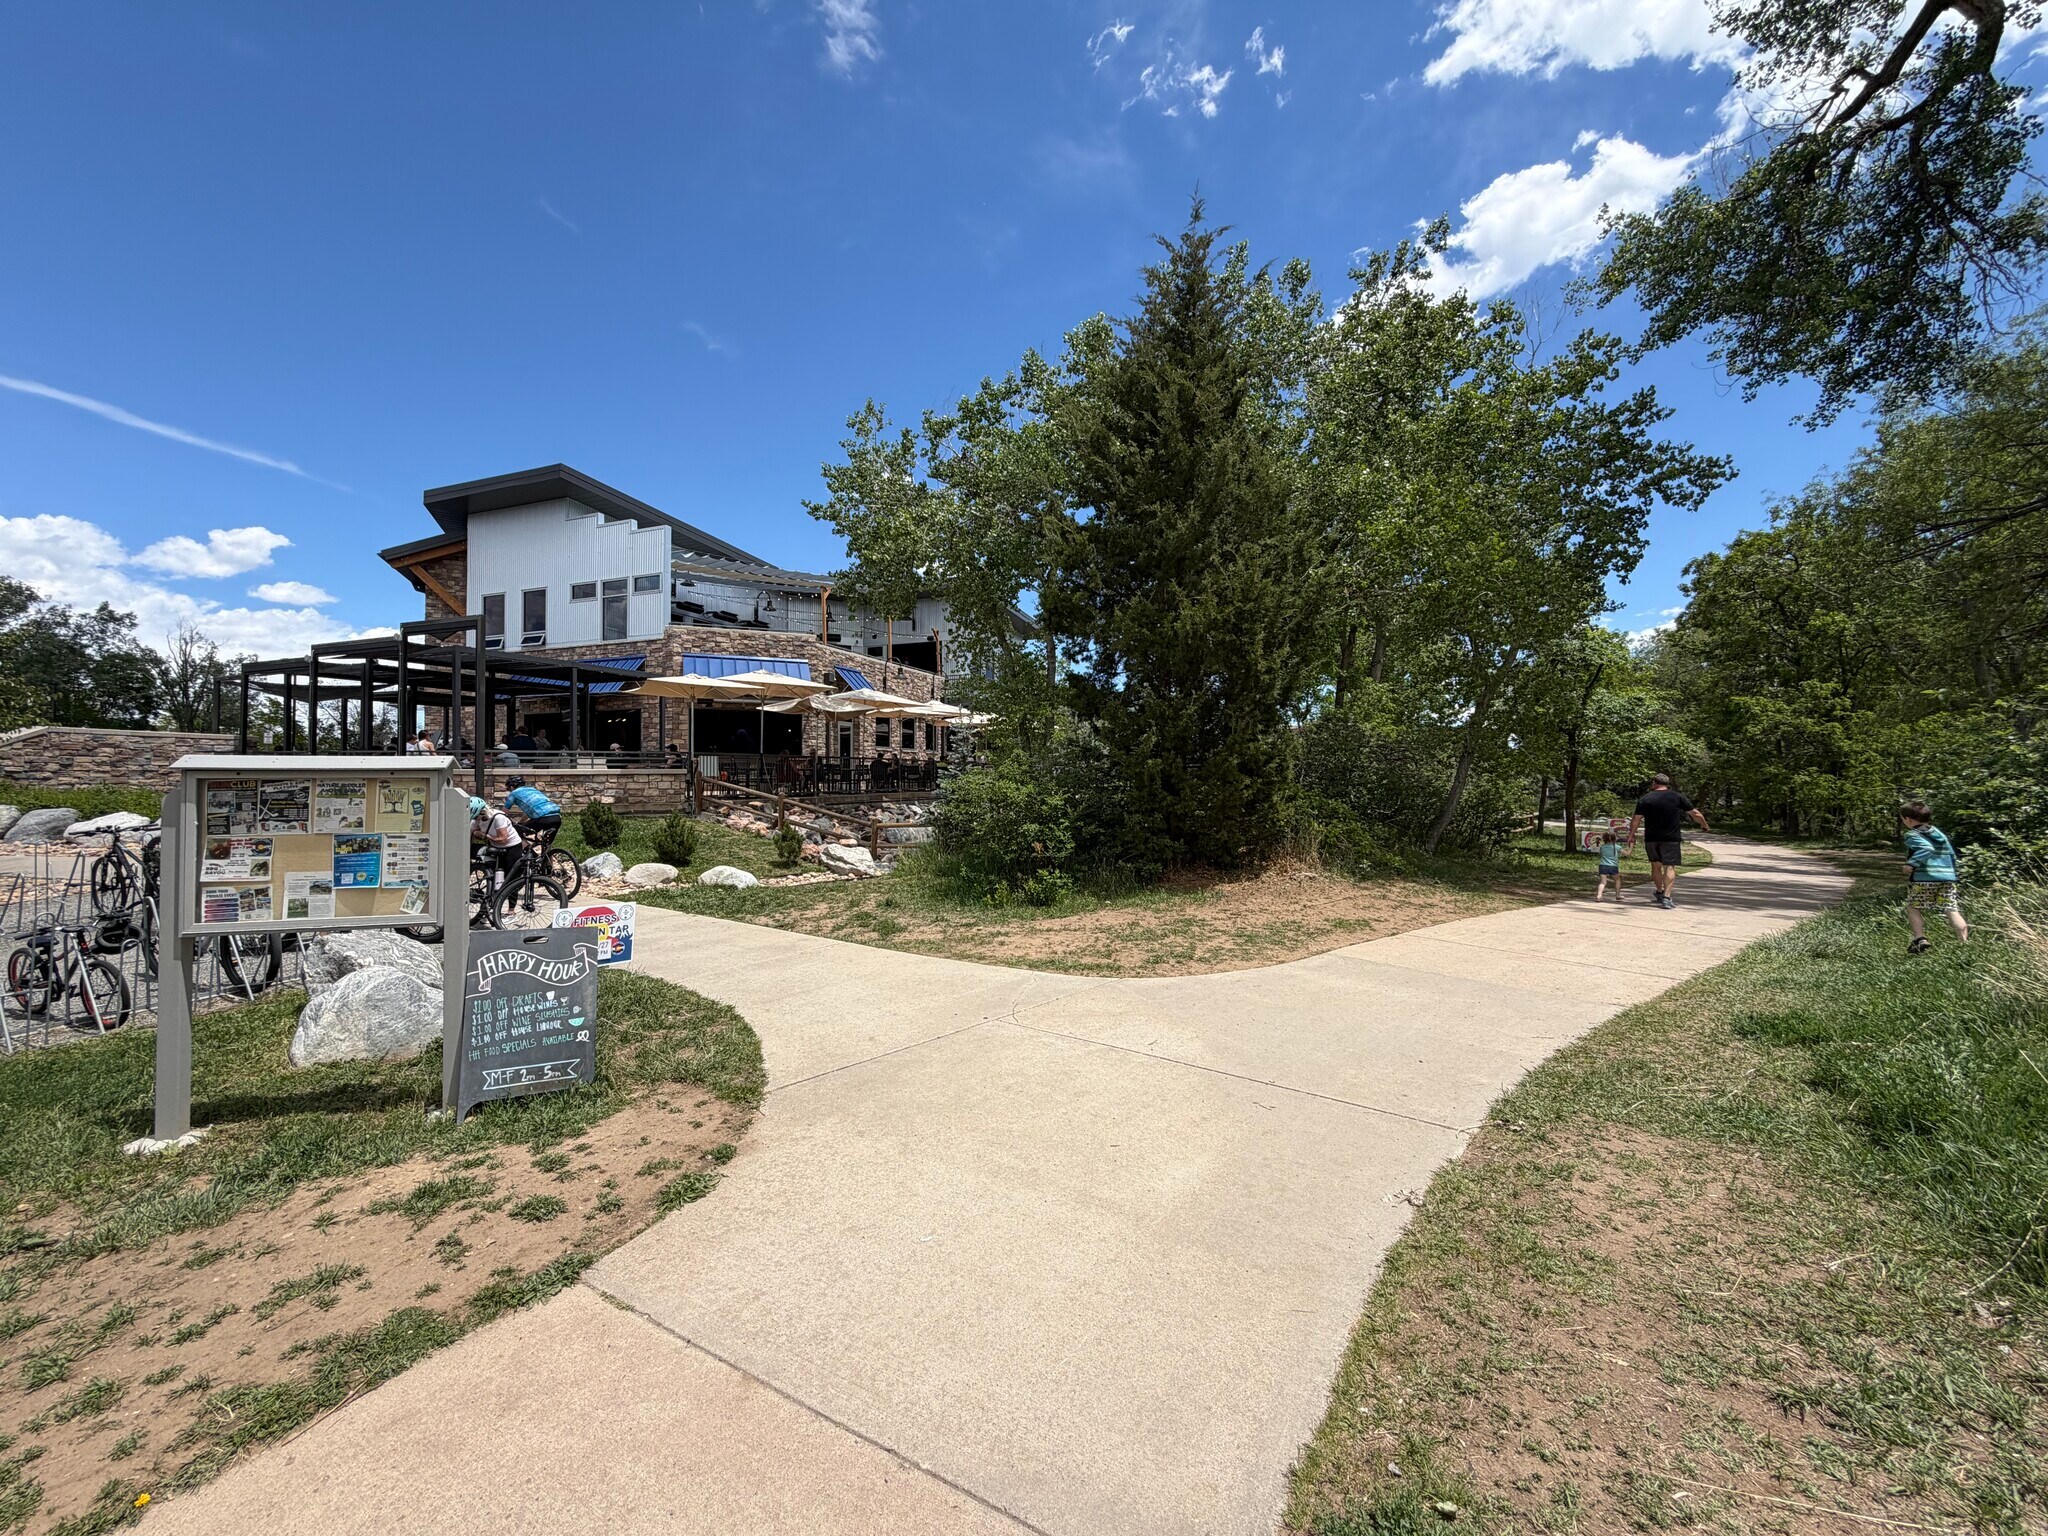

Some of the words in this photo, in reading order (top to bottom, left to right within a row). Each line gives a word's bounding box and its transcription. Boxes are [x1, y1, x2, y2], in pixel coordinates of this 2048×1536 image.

[230, 780, 257, 788] CLUB
[574, 914, 618, 927] FITNESS
[482, 952, 536, 977] HAPPY
[537, 960, 584, 981] HOUR
[511, 991, 544, 1008] DRAFTS
[536, 999, 559, 1010] WINES
[471, 1024, 492, 1037] $1.00
[495, 1019, 508, 1031] OFF
[511, 1014, 532, 1028] WINE
[534, 1006, 571, 1022] SLUSHIES
[494, 1030, 508, 1041] OFF
[468, 1050, 481, 1062] HH
[484, 1045, 501, 1058] FOOD
[501, 1038, 537, 1055] SPECIALS
[490, 1069, 515, 1086] M-F
